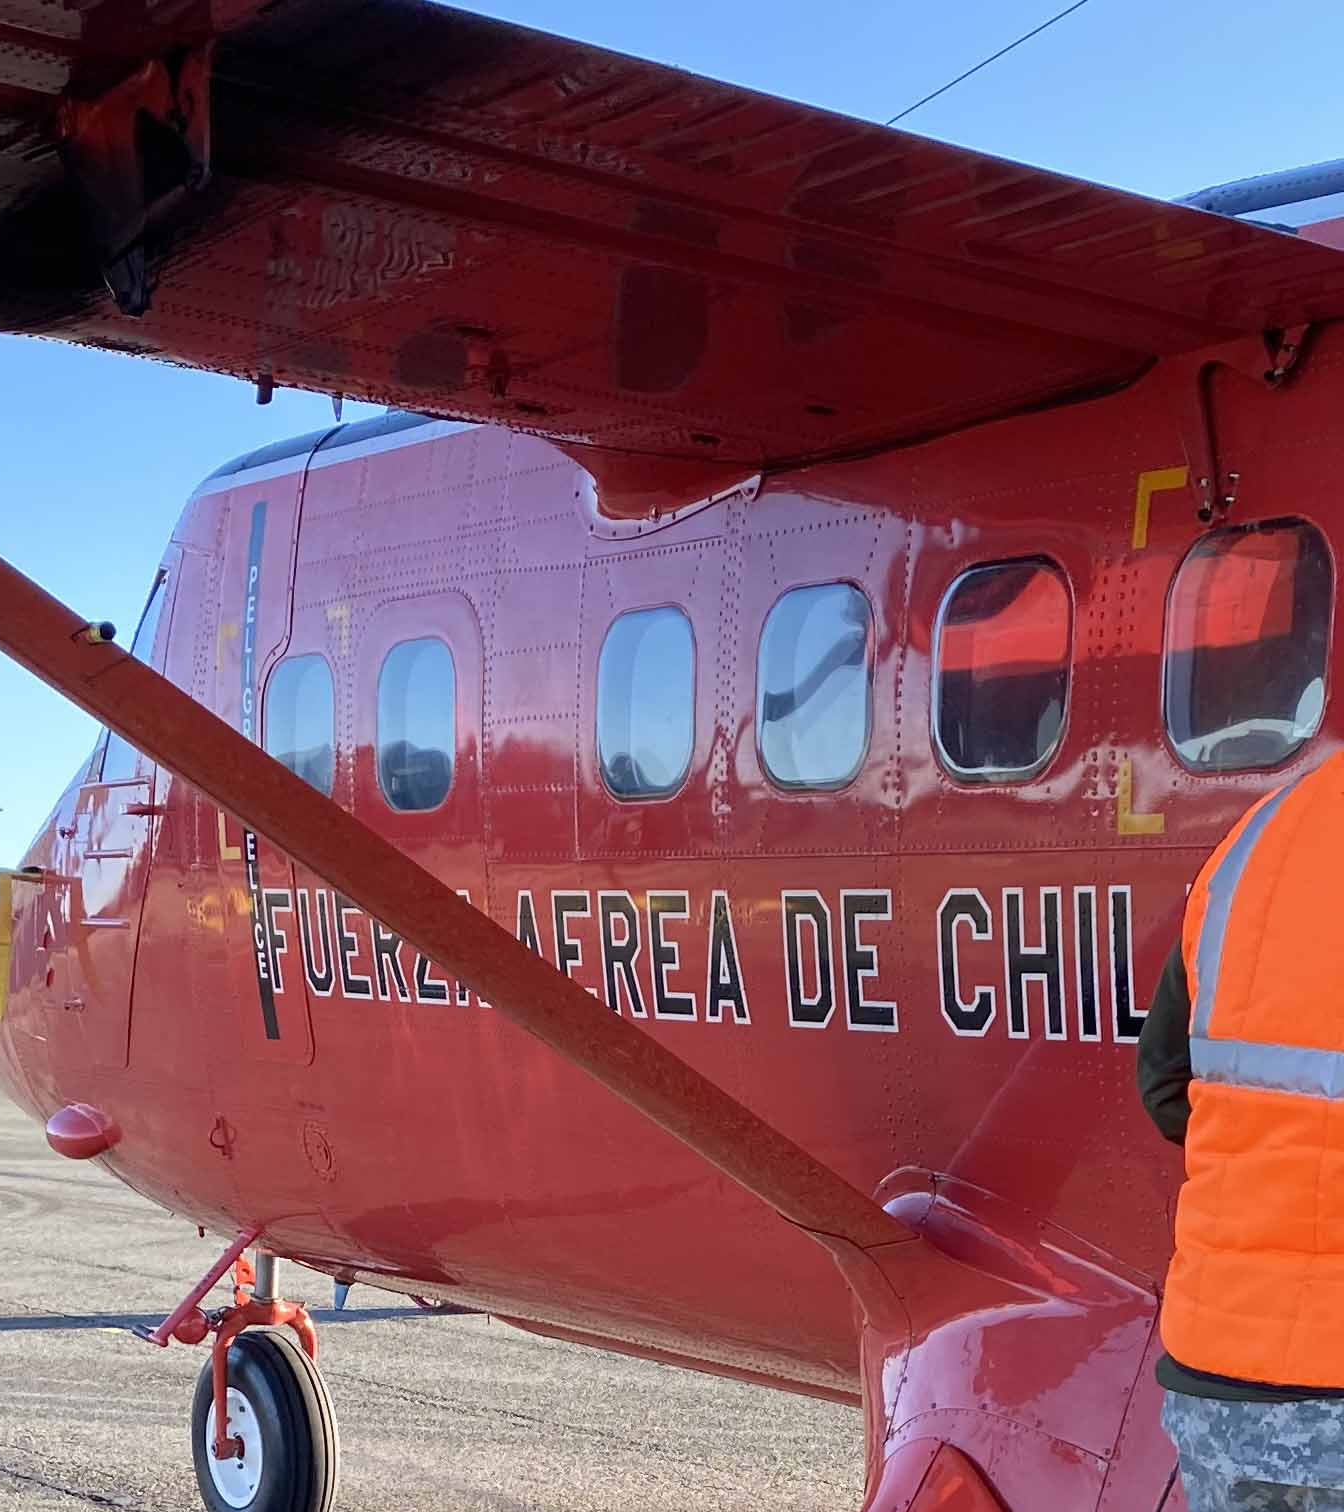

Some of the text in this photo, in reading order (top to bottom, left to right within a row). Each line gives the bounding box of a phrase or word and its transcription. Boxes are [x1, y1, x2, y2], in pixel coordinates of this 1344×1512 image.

[242, 565, 258, 740] PELIGR
[246, 833, 269, 980] ELICE
[261, 888, 494, 1009] FUER
[781, 888, 899, 1033] DE
[936, 883, 1192, 1044] CHIL
